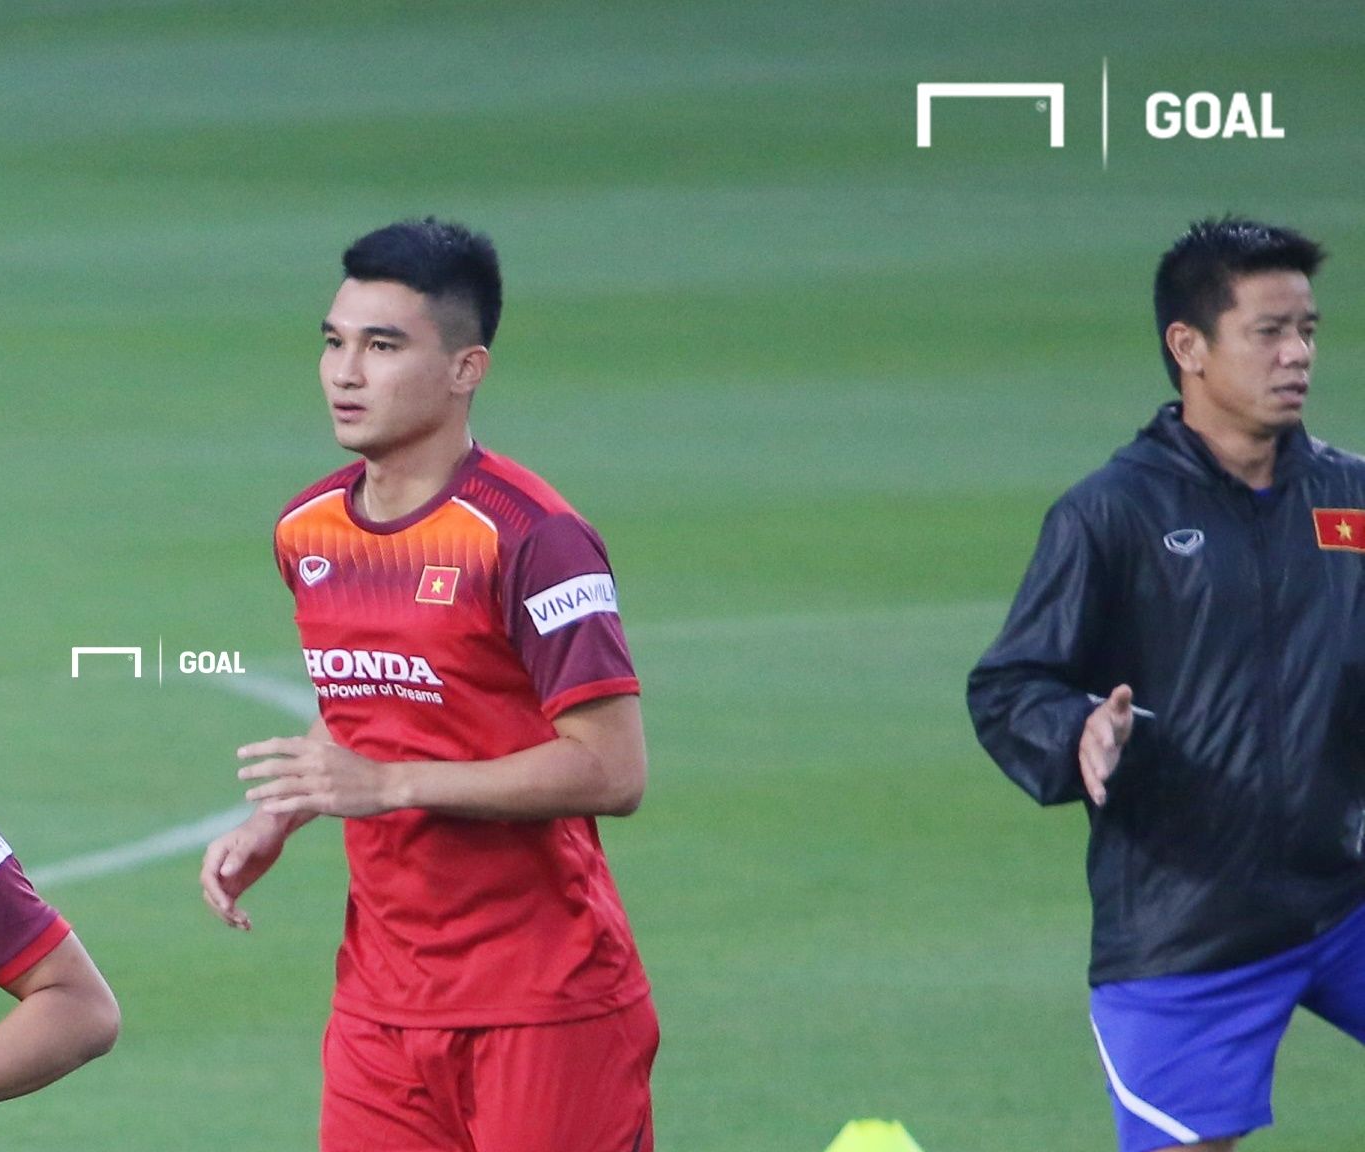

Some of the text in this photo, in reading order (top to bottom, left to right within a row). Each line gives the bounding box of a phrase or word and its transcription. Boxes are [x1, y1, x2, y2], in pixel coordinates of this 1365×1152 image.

[303, 649, 444, 686] HONDA
[330, 683, 377, 698] Power
[379, 684, 394, 698] of
[395, 685, 443, 704] Dreams
